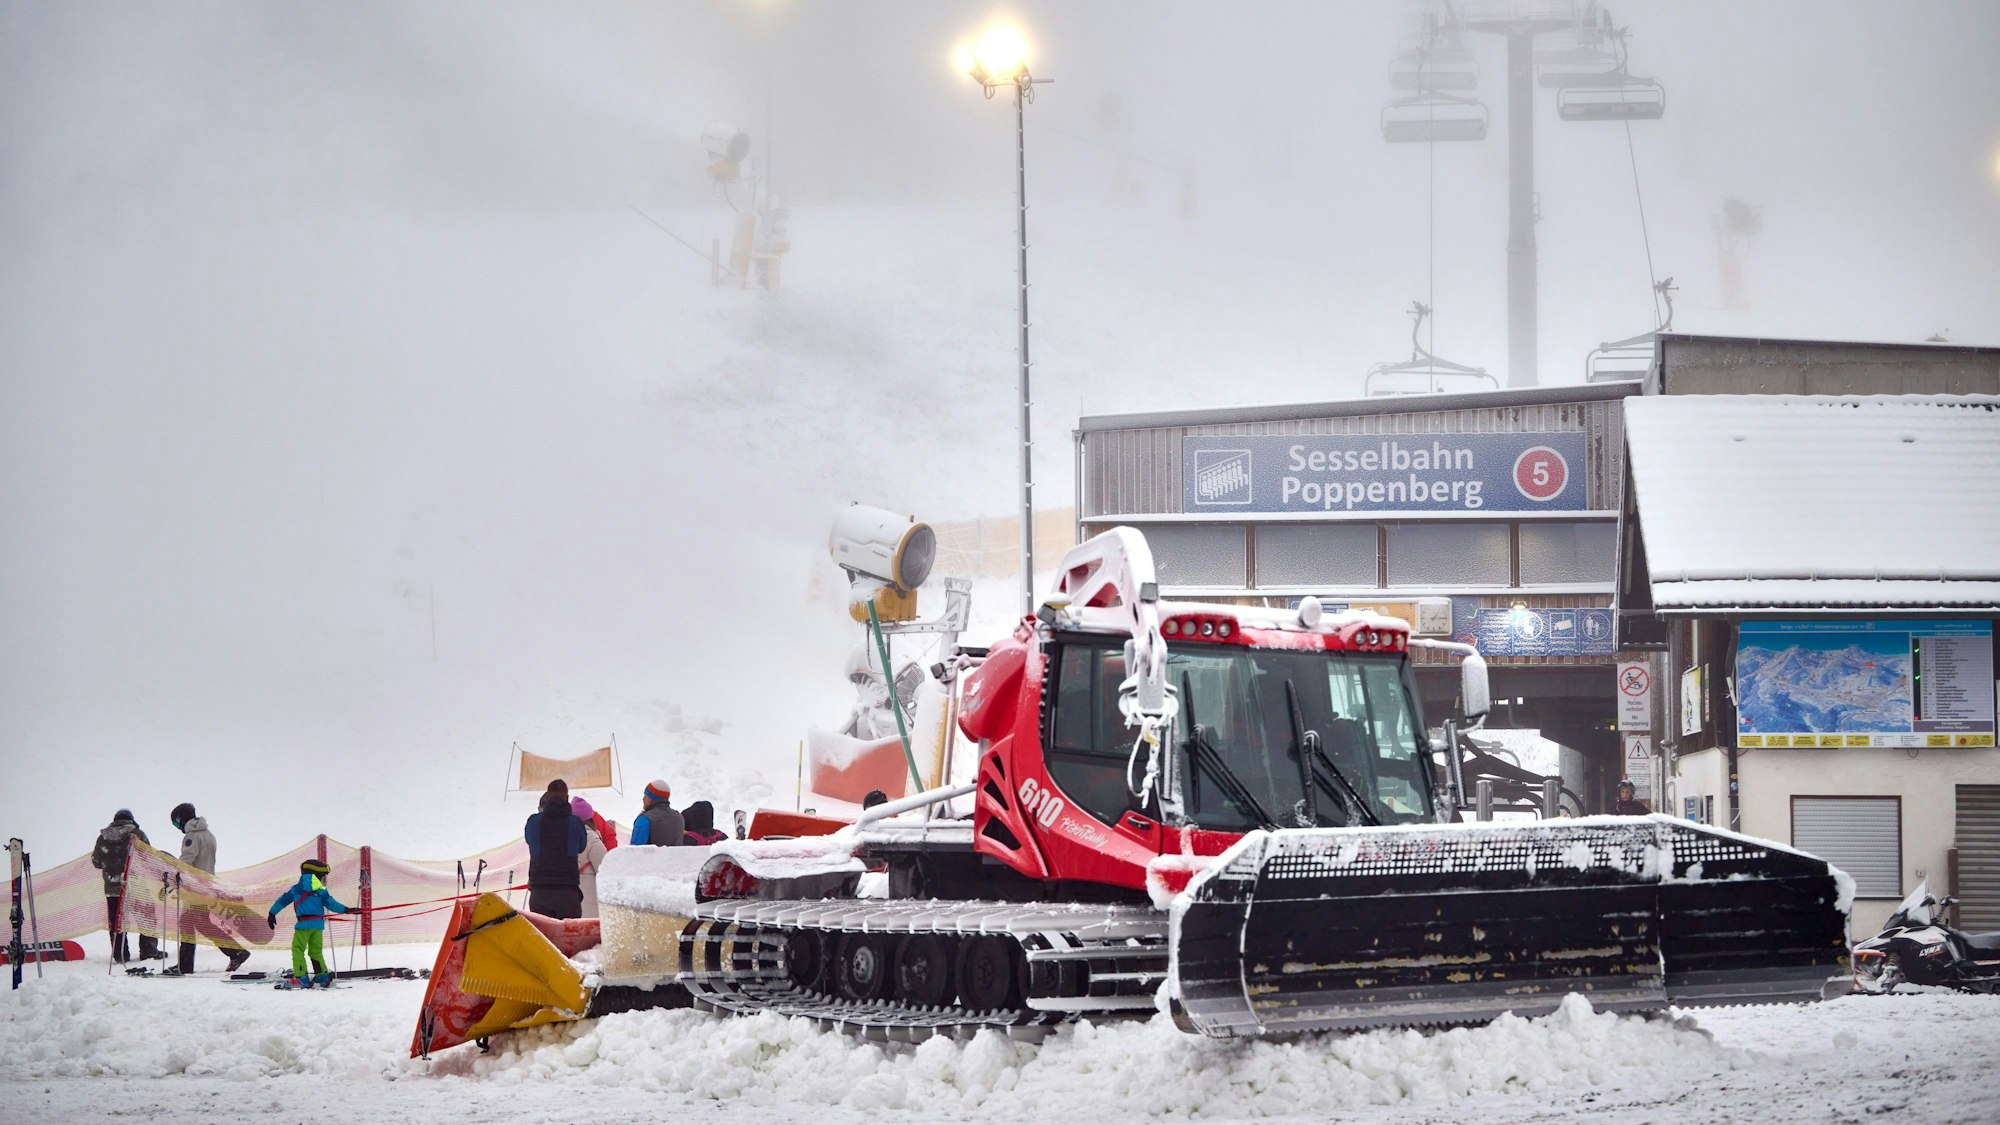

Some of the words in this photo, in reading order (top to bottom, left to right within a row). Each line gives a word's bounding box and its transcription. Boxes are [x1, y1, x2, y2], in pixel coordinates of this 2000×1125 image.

[1288, 442, 1474, 472] Sesselbahn
[1533, 461, 1550, 486] 5
[1282, 474, 1484, 510] Poppenberg
[1918, 944, 1944, 957] LYNX
